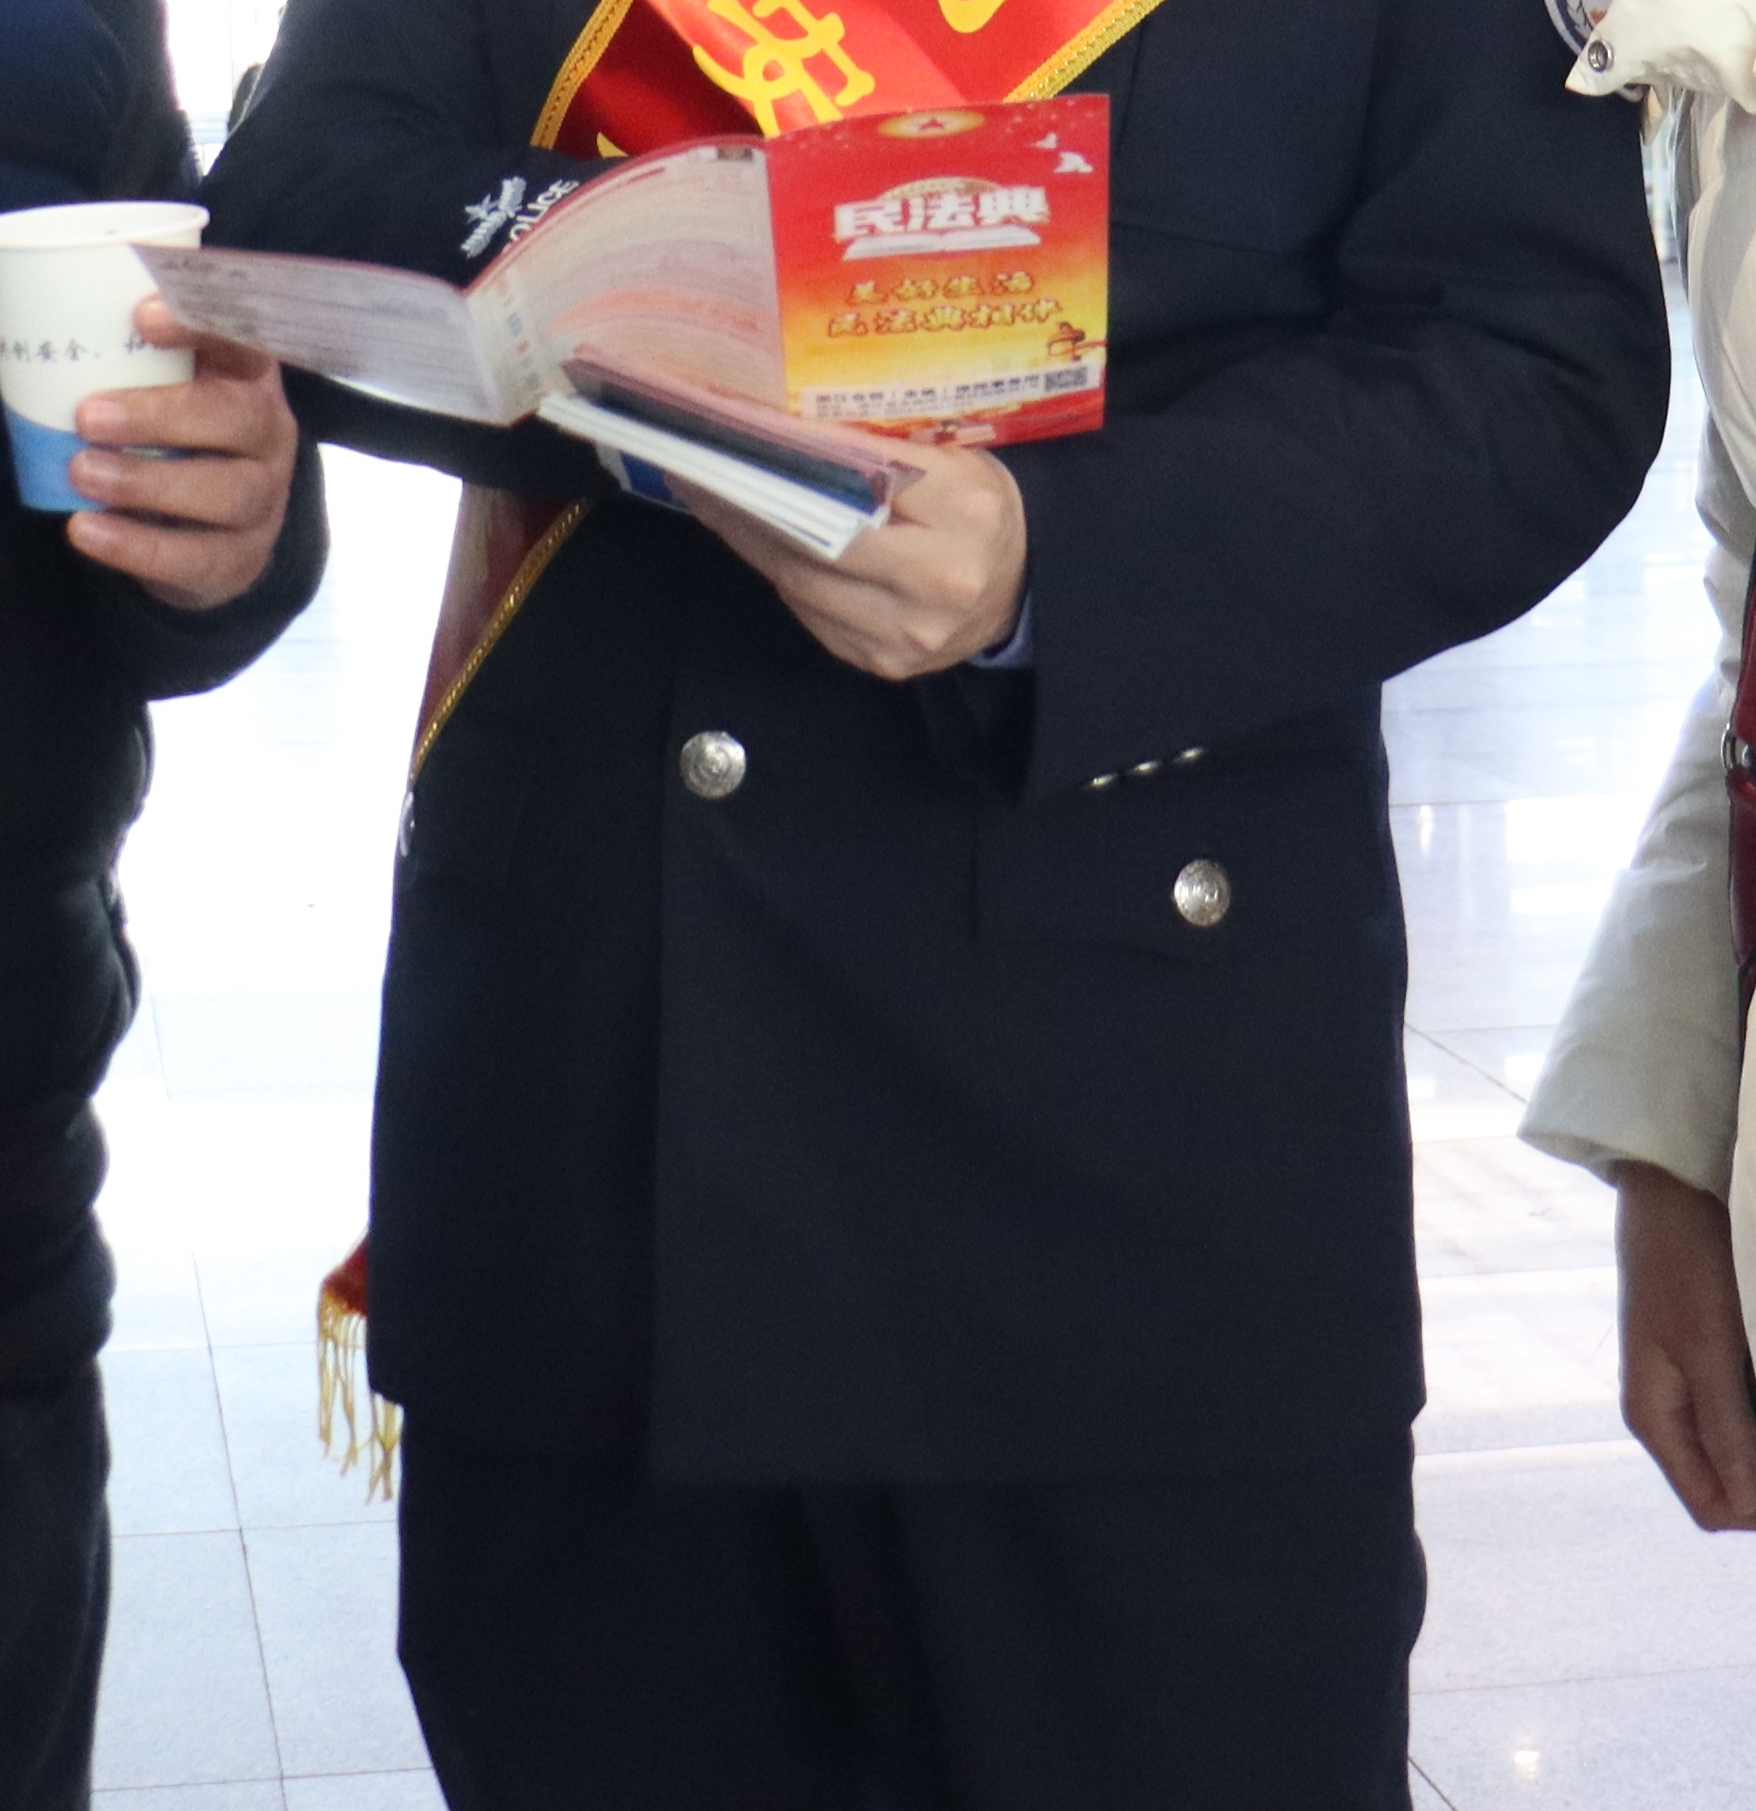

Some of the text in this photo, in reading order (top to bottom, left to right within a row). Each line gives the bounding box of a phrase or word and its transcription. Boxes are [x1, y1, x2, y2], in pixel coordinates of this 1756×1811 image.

[501, 179, 580, 254] OLICE
[833, 186, 1050, 244] 民法典
